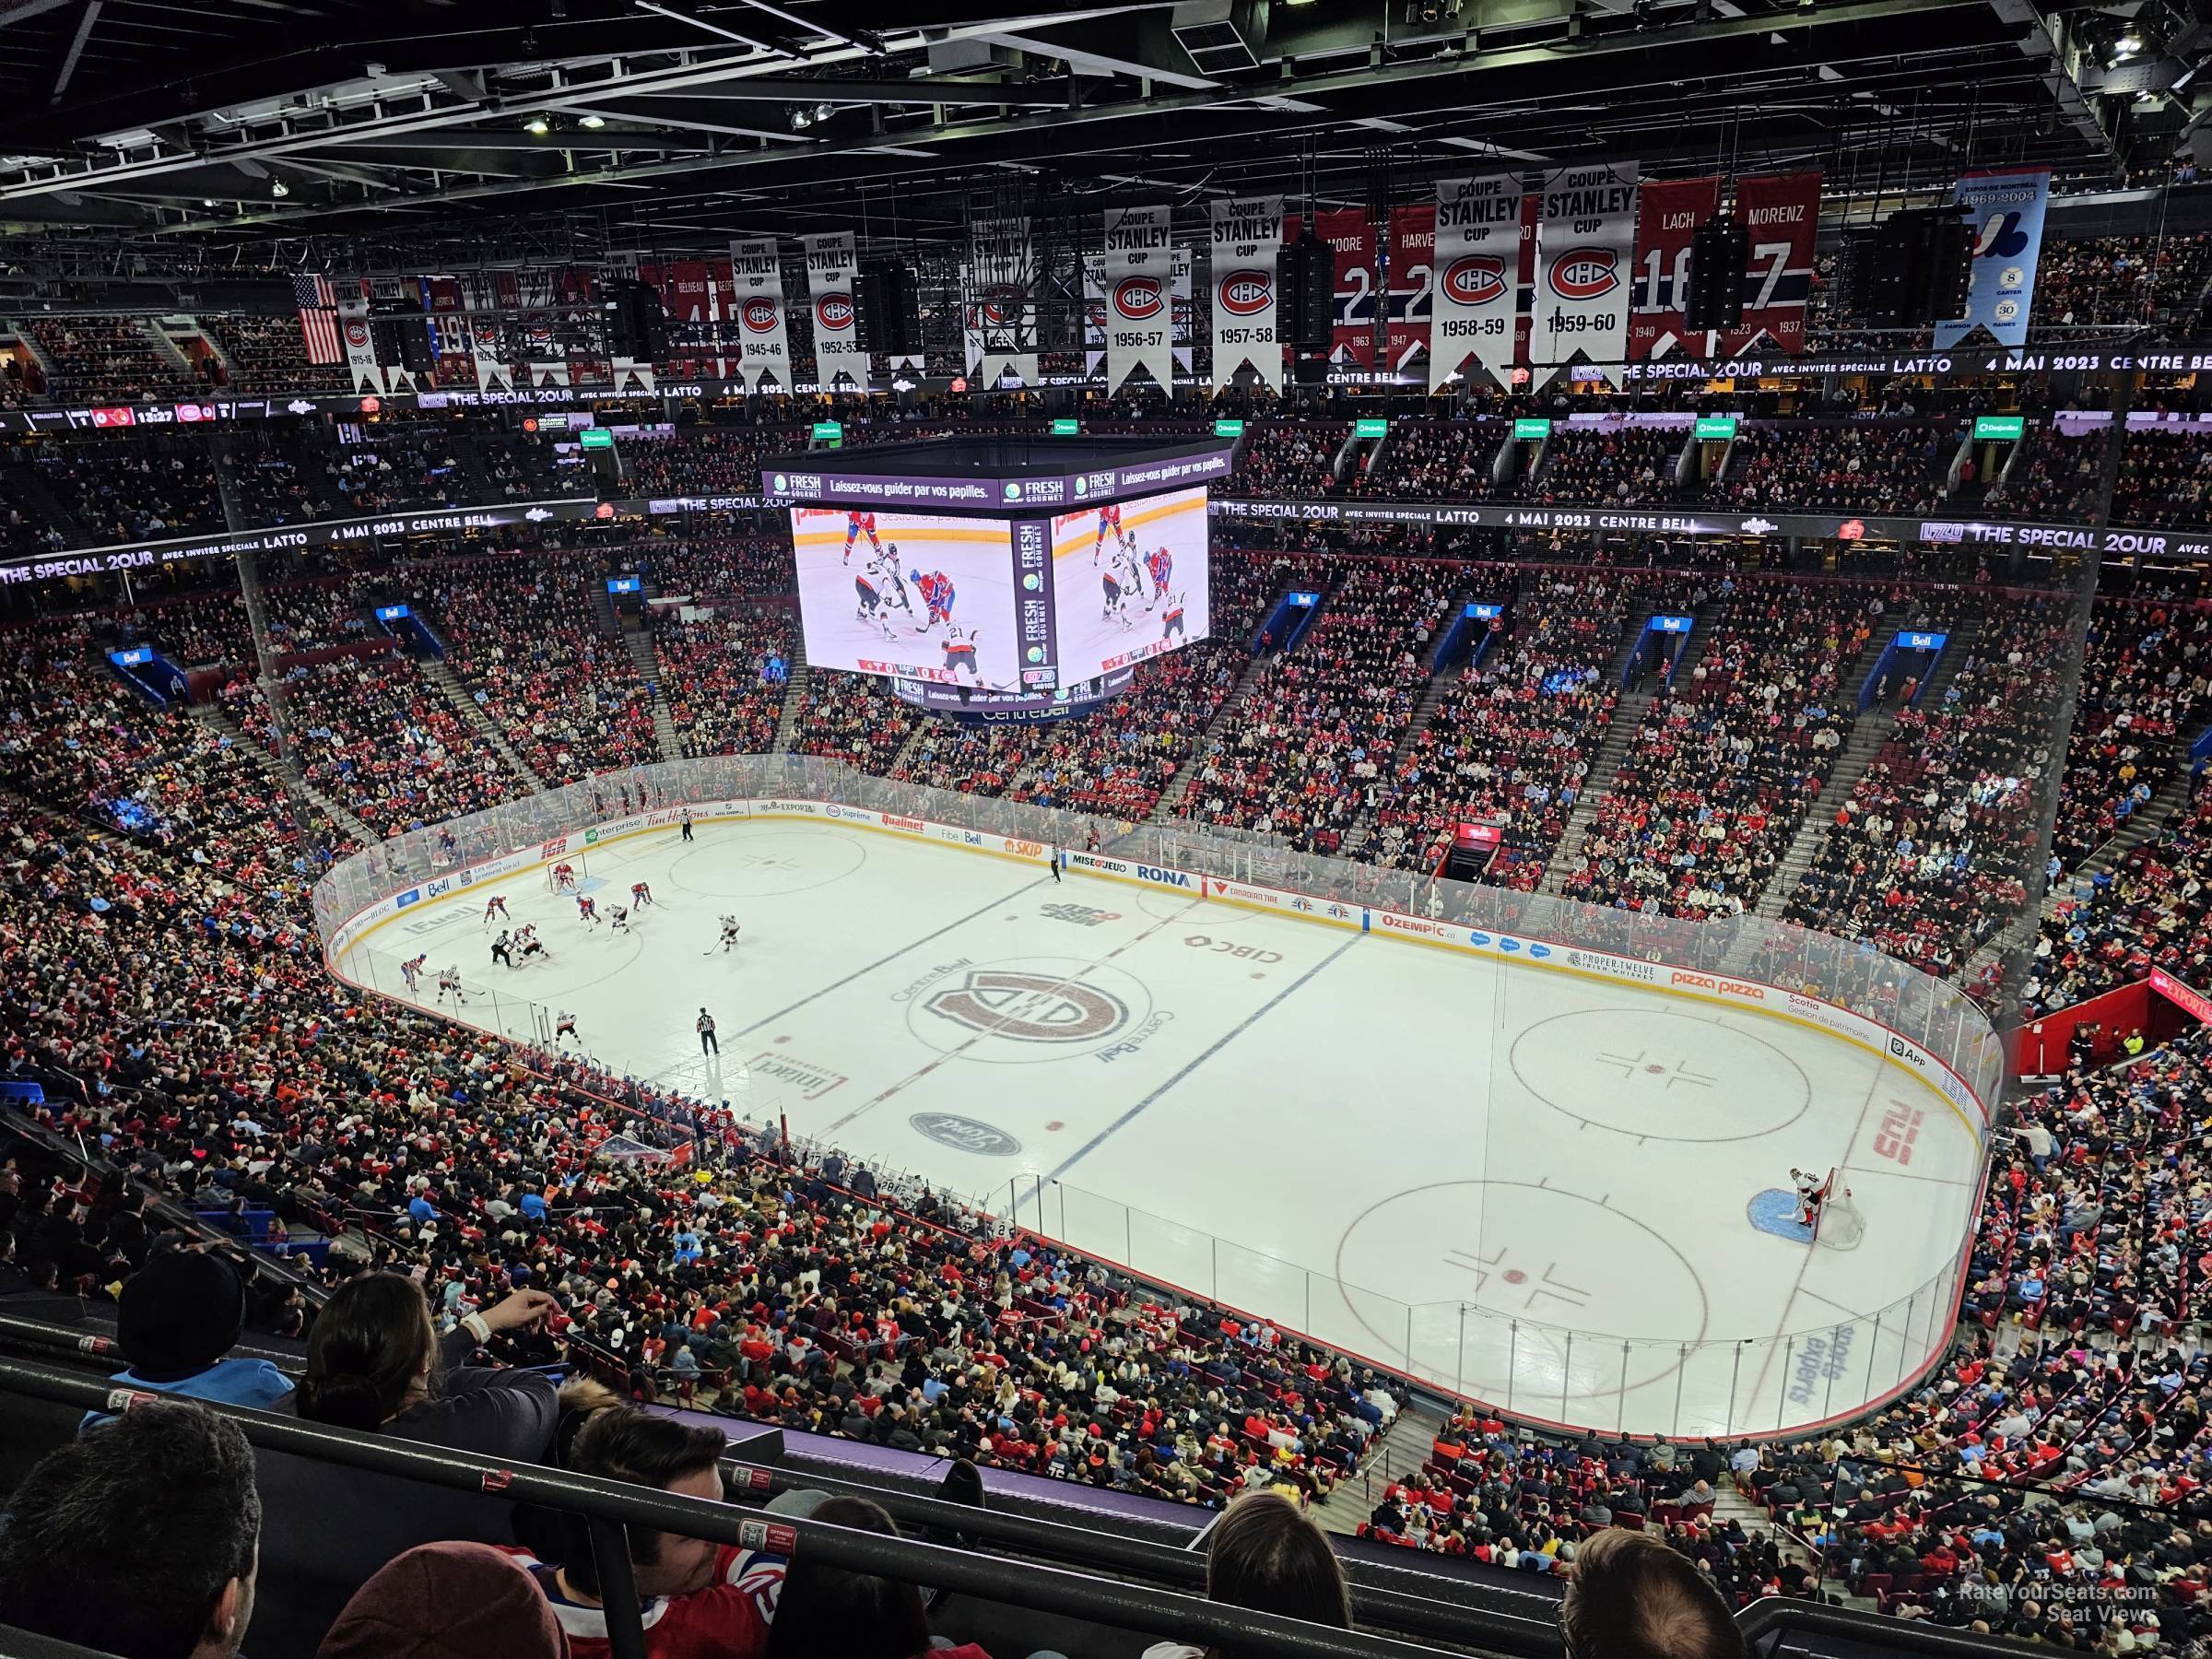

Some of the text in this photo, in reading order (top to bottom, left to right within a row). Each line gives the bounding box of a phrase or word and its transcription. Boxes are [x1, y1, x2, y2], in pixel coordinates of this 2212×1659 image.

[1568, 170, 1615, 188] COUPE
[1457, 180, 1501, 197] COUPE
[1547, 186, 1635, 218] STANLEY
[1961, 191, 2037, 206] 1969-2004
[1229, 202, 1265, 218] COUPE
[1439, 195, 1520, 227] STANLEY
[1747, 204, 1805, 226] MORENZ
[1121, 212, 1155, 226] COUPE
[1573, 218, 1602, 234] CUP
[1662, 211, 1695, 229] LACH
[1214, 217, 1280, 242] STANLEY
[1464, 227, 1490, 241] CUP
[817, 236, 842, 248] COUPE
[1108, 226, 1170, 250] STANLEY
[741, 243, 766, 254] COUPE
[1236, 245, 1258, 257] CUP
[734, 255, 777, 275] STANLEY
[808, 249, 853, 270] STANLEY
[1127, 252, 1148, 265] CUP
[749, 276, 765, 287] CUP
[825, 271, 841, 282] CUP
[1752, 241, 1792, 311] 7
[2006, 273, 2016, 283] 8
[1998, 305, 2014, 314] 30
[1441, 317, 1505, 337] 1958-59
[1547, 313, 1616, 333] 1959-60
[1779, 320, 1800, 333] 1937
[1113, 331, 1163, 347] 1956-57
[1219, 327, 1273, 344] 1957-58
[1635, 326, 1655, 338] 1940
[820, 341, 858, 354] 1952-53
[1352, 335, 1370, 347] 1963
[1390, 335, 1406, 346] 1947
[745, 343, 782, 356] 1945-46
[1646, 356, 2100, 379] SPECIAL AVEC INVITÉE SPÉCIALE LATTO 4 MAI 2023
[1326, 373, 1371, 384] CENTRE
[453, 391, 535, 406] THE SPECIAL
[664, 386, 702, 397] LATTO
[723, 385, 730, 394] 4
[96, 412, 108, 424] 0
[138, 411, 173, 424] 13:27
[1122, 457, 1226, 486] Laissez-vous guider par vos papilles.
[790, 475, 821, 489] FRESH
[1026, 481, 1064, 494] FRESH
[1088, 472, 1115, 488] FRESH
[791, 490, 822, 499] GOURMET
[830, 480, 883, 495] Laissez-vous
[885, 482, 912, 497] guider
[914, 485, 930, 497] par
[932, 486, 947, 496] vos
[948, 484, 989, 500] papilles.
[1089, 488, 1115, 499] GOURMET
[683, 497, 759, 511] THE SPECIAL
[1026, 494, 1064, 503] GOURMET
[1224, 502, 1247, 516] THE
[1250, 504, 1300, 518] SPECIAL
[1365, 509, 1394, 519] INVITÉE
[1395, 510, 1431, 520] SPÉCIALE
[1436, 511, 1479, 523] LATTO
[1504, 514, 1513, 524] 4
[1520, 513, 1548, 525] MAI
[1555, 514, 1591, 526] 2023
[1600, 516, 1655, 529] CENTRE
[1662, 517, 1697, 530] BELL
[1020, 524, 1034, 569] FRESH
[1974, 526, 2209, 555] THE SPECIAL AVEC
[2, 569, 32, 584] THE
[34, 558, 104, 579] SPECIAL
[161, 551, 183, 560] AVEC
[264, 533, 307, 549] LATTO
[331, 528, 338, 541] 4
[343, 524, 370, 539] MAI
[373, 521, 405, 535] 2023
[412, 516, 461, 531] CENTRE
[1298, 594, 1311, 604] Bell
[386, 607, 398, 618] Bell
[1477, 606, 1491, 616] Bell
[1025, 600, 1039, 641] FRESH
[1664, 618, 1680, 629] Bell
[949, 627, 964, 639] 21
[1912, 635, 1931, 646] Bell
[124, 653, 140, 663] Bell
[646, 811, 665, 827] Tim
[841, 808, 871, 820] Suprême
[881, 813, 925, 830] Qualinet
[587, 818, 641, 841] enterprise
[941, 829, 959, 841] Fibe
[964, 831, 982, 845] Bell
[1016, 841, 1042, 858] SKIP
[485, 860, 501, 871] idées
[476, 867, 502, 882] prennent
[1137, 865, 1191, 888] RONA
[428, 878, 450, 898] Bell
[1230, 887, 1264, 901] CANADIAN
[1264, 893, 1278, 904] TIRE
[1210, 941, 1284, 963] CIBC
[1582, 963, 1654, 981] IRISH WHISKEY
[1671, 971, 1764, 1000] pizza pizza
[1788, 994, 1819, 1011] Scotia
[1788, 1005, 1870, 1041] Gestion de patrimoine
[928, 1118, 1004, 1149] Ford
[881, 1181, 894, 1193] 28
[1787, 1335, 1827, 1406] experts
